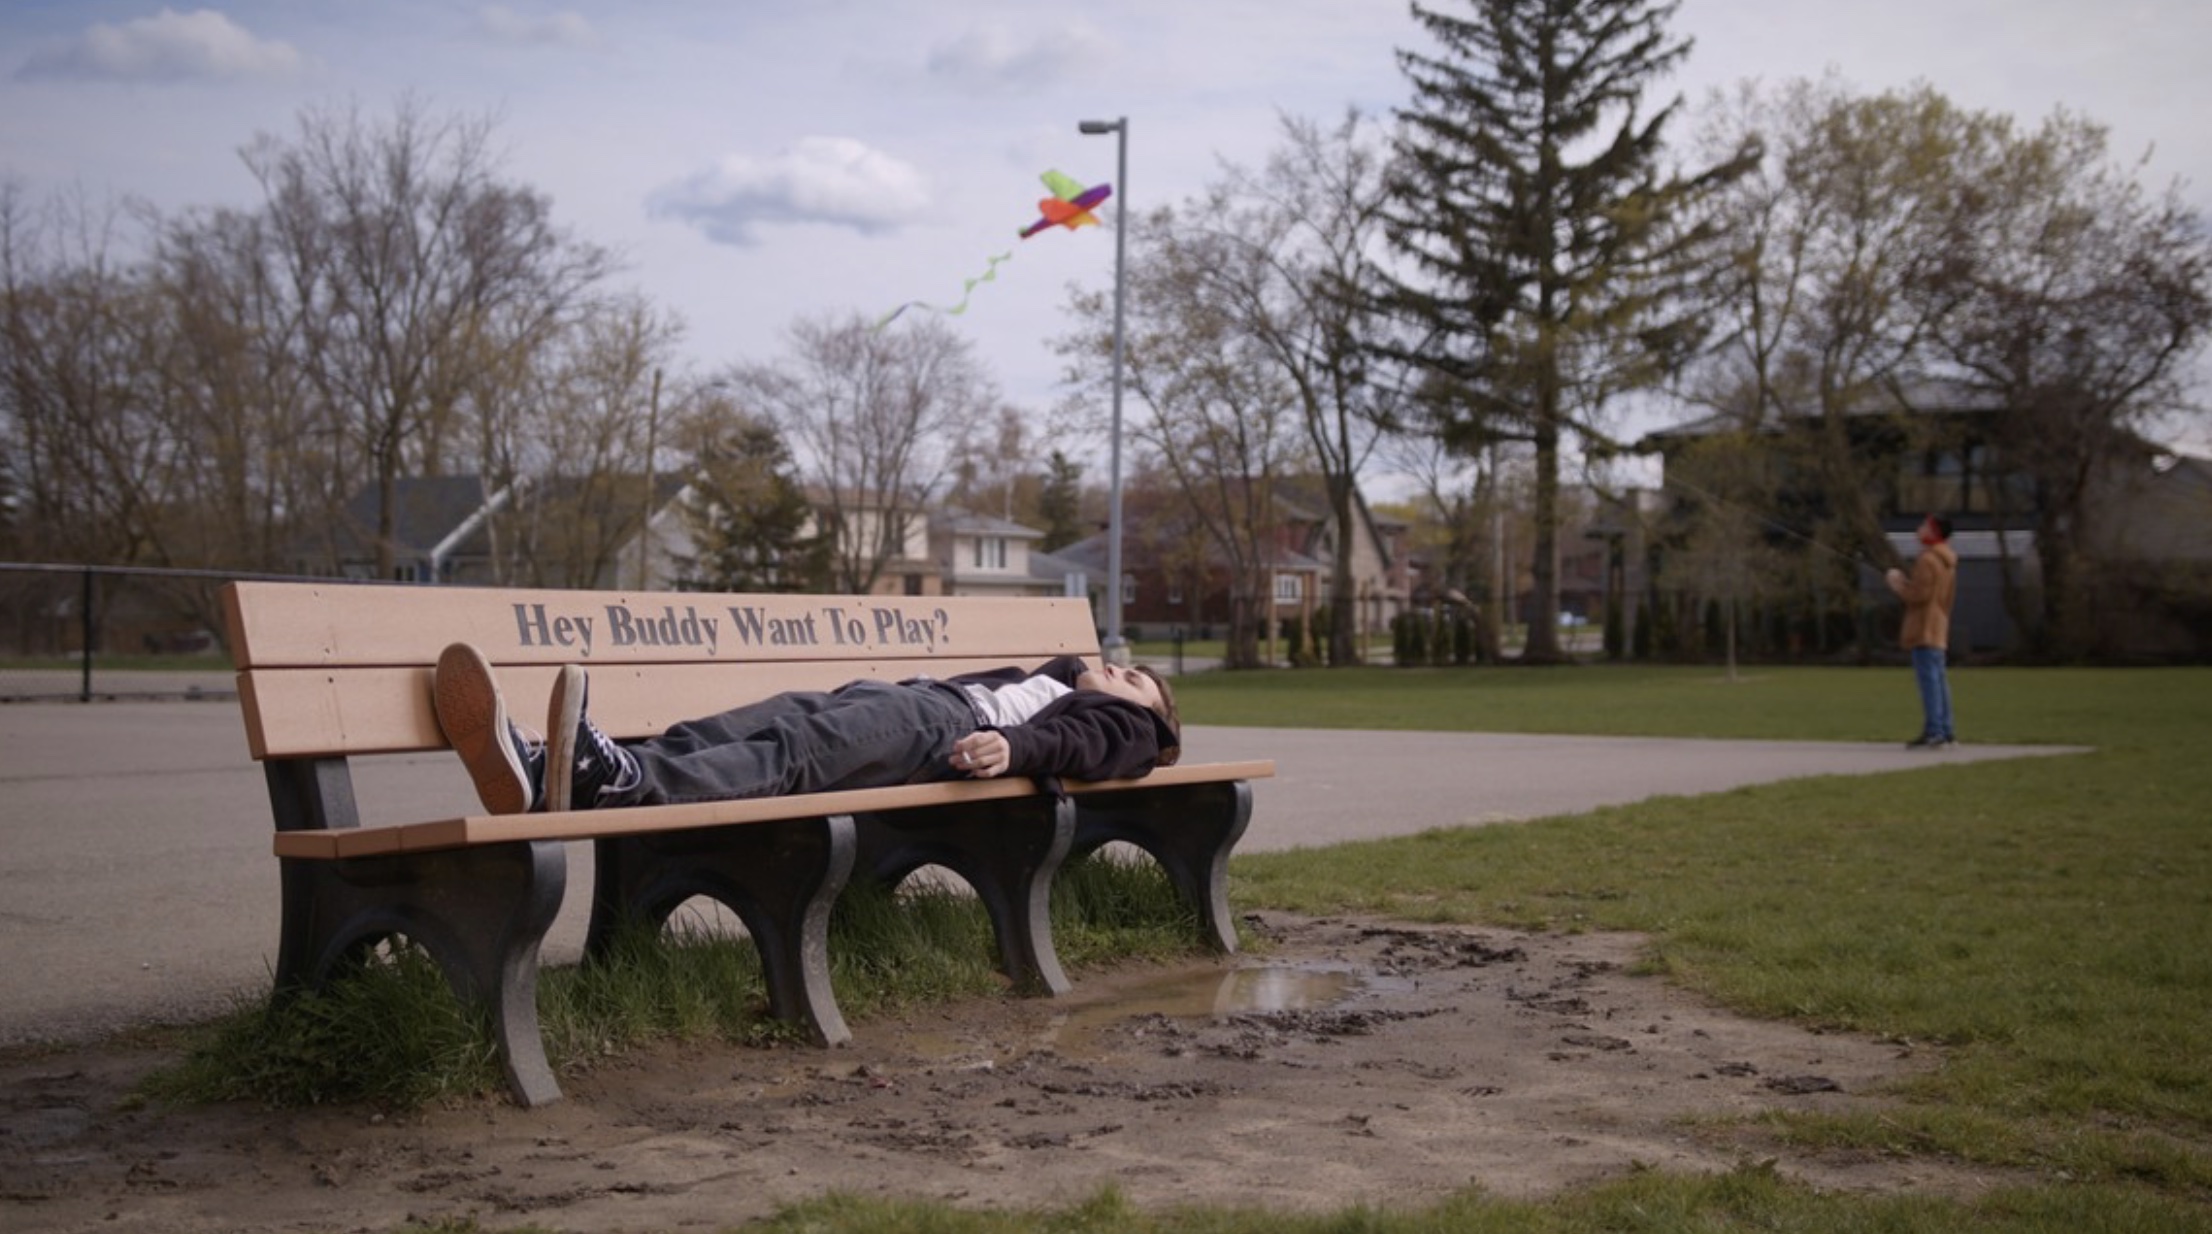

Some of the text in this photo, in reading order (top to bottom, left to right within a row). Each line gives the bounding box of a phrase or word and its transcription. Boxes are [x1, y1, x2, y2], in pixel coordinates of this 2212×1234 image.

[511, 603, 949, 657] Hey Buddy Want To Play?
